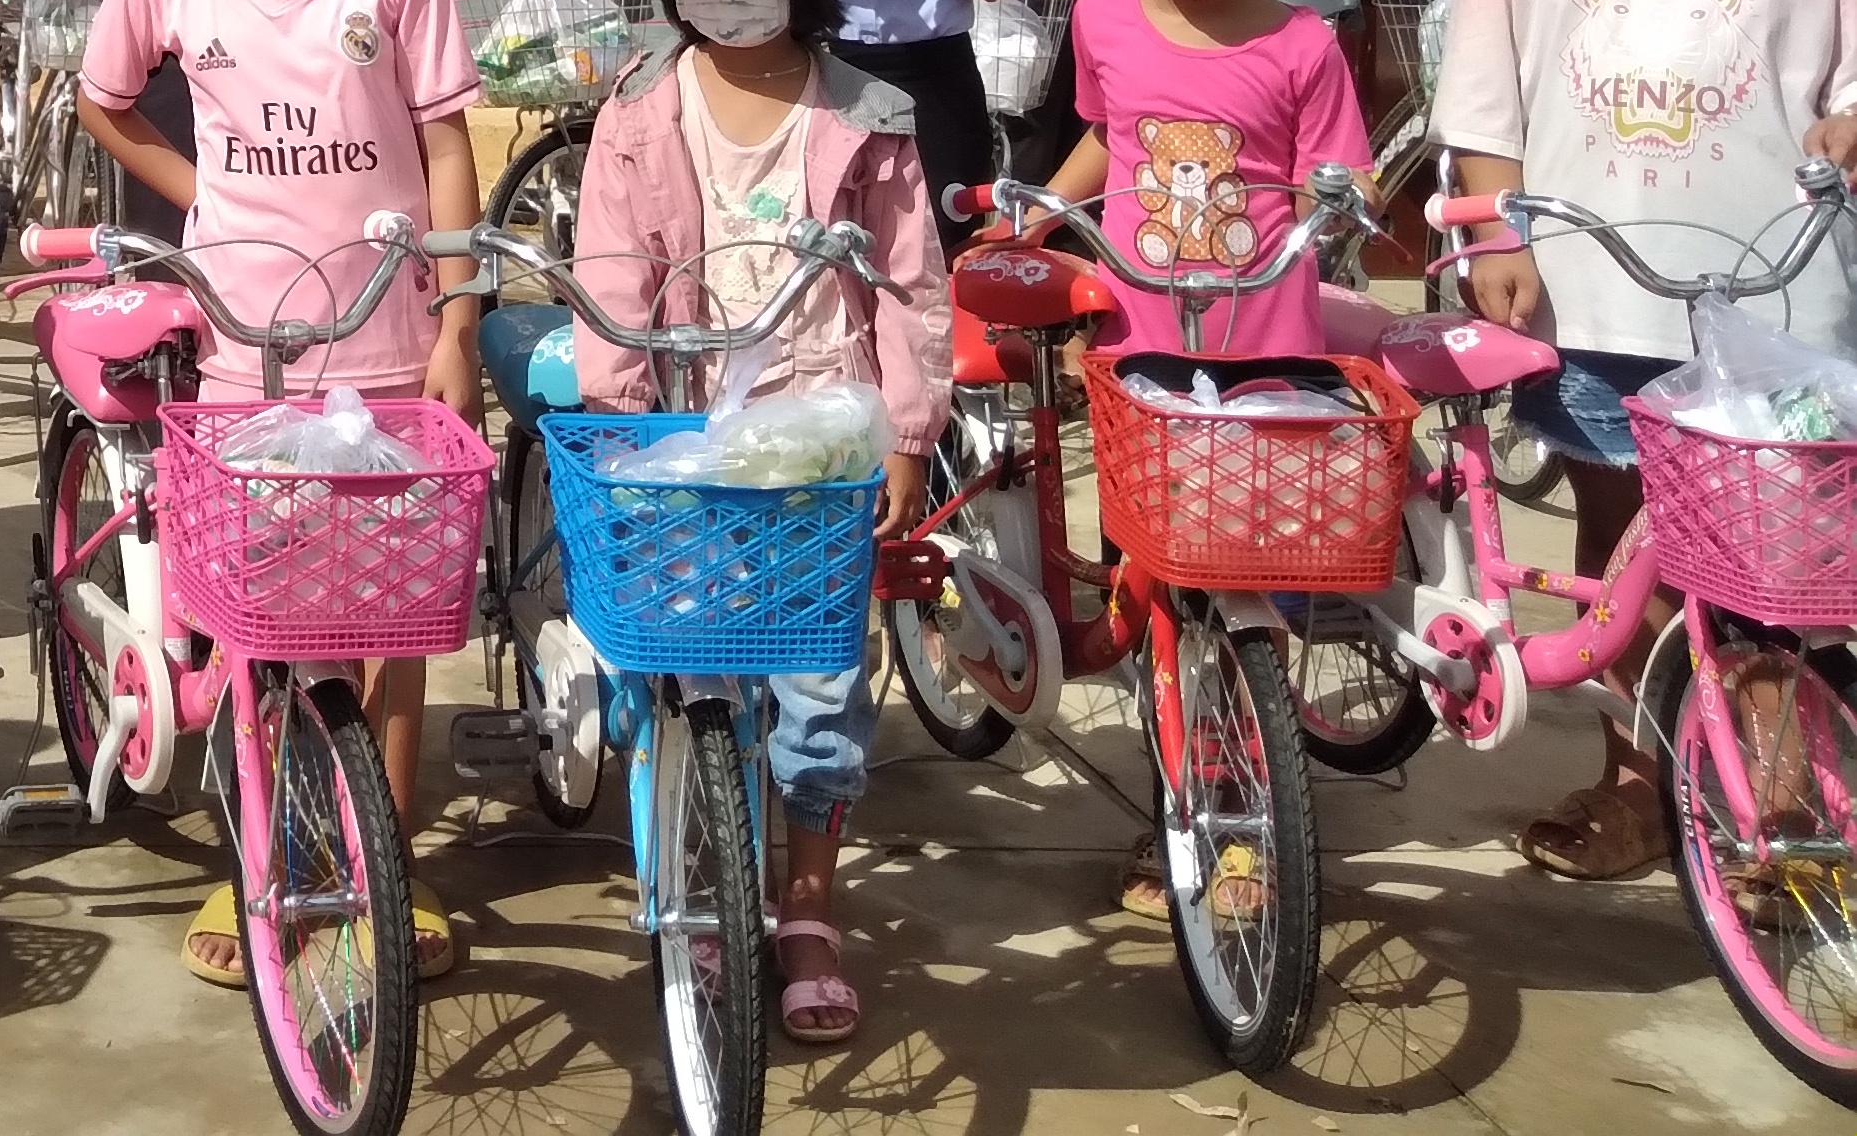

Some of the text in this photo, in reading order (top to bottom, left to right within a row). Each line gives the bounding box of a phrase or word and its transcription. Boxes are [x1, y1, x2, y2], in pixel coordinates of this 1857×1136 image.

[196, 57, 237, 71] adidas
[1589, 76, 1726, 116] KENZO
[261, 101, 317, 138] Fly
[224, 135, 379, 176] Emirates
